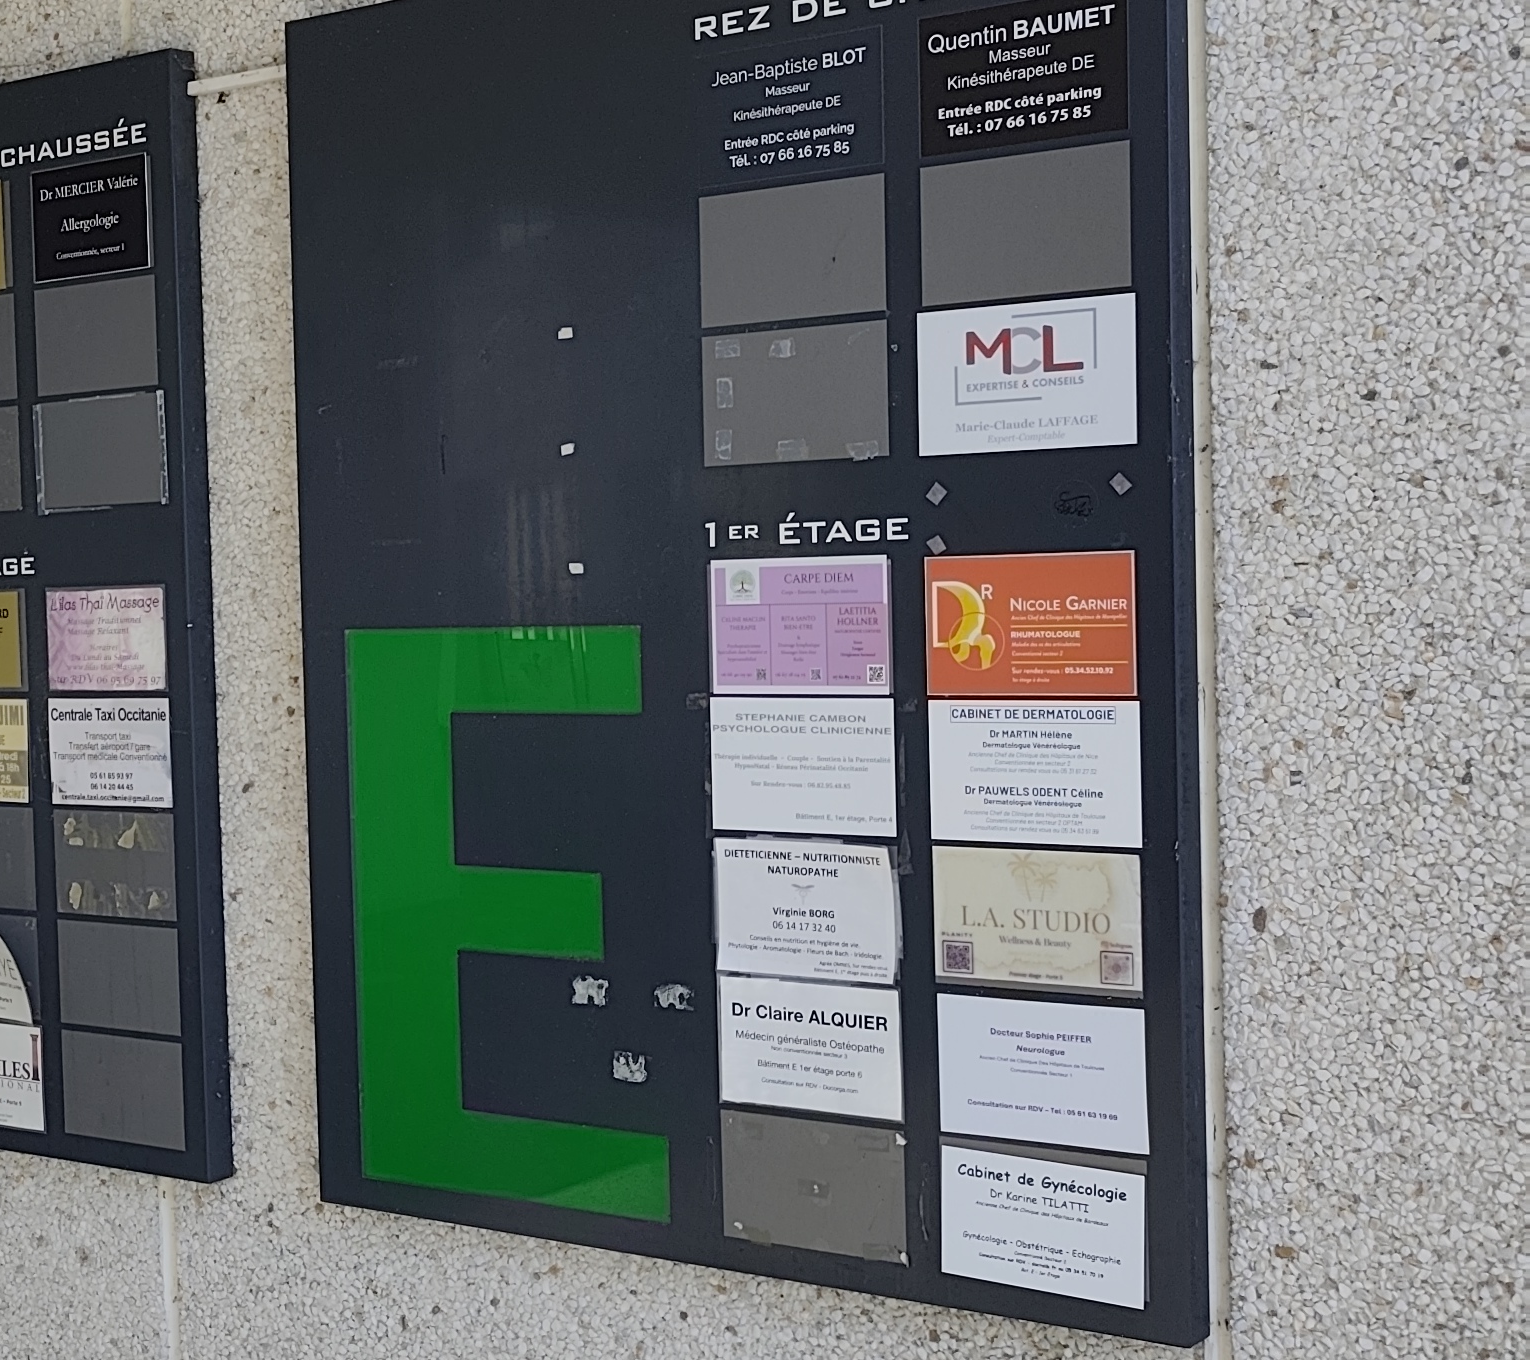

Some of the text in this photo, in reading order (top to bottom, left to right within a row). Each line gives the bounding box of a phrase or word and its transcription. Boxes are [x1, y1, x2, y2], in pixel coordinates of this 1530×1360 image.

[693, 4, 771, 41] REZ
[928, 4, 1115, 53] Quentin BAUMET
[989, 44, 1051, 64] Masseur
[712, 47, 866, 87] Jean-Baptiste BLOT
[947, 55, 1095, 90] Kinésithérapeute DE
[766, 82, 810, 97] Masseur
[734, 95, 841, 122] Kinésithérapeute DE
[938, 87, 1102, 119] Entrée RDC côté parking
[947, 105, 1091, 137] Tél. 07 66 16 75 85
[0, 118, 146, 168] CHAUSSÉE
[725, 123, 854, 150] Entrée RDC côté parking
[730, 141, 850, 167] Tél. 07 66 16 75 85
[40, 175, 138, 201] Dr MERCIER Valérie
[61, 213, 119, 233] Allergologie
[966, 325, 1084, 375] MCL
[967, 376, 1084, 393] EXPERTISE & CONSEILS
[955, 415, 1098, 432] Marie-Claude LAFFAGE
[987, 431, 1065, 444] Expert-Comptable
[779, 512, 909, 544] ÉTAGE
[784, 573, 854, 583] CARPE DIEM
[51, 597, 76, 611] Lilas
[106, 594, 159, 613] Massage
[839, 607, 876, 615] LAETITIA
[837, 618, 878, 626] HOLLNER
[51, 708, 166, 721] Centrale Taxi Occitanie
[736, 713, 866, 723] STEPHANIE CAMBON
[952, 709, 1115, 720] CABINET DE DERMATOLOGIE
[713, 725, 891, 735] PSYCHOLOGUE CLINICIENNE
[989, 730, 1072, 739] Dr MARTIN Hélène
[965, 786, 1103, 799] Dr PAUWELS ODENT Céline
[725, 849, 880, 865] DIETETICIENNE NUTRITIONNISTE
[768, 865, 839, 878] NATUROPATHE
[773, 907, 835, 918] Virginie BORG
[961, 905, 1111, 934] L.A. STUDIO
[344, 625, 670, 1225] E
[773, 921, 836, 933] 06 14 17 32 40
[732, 1002, 888, 1031] Dr Claire ALQUIER
[735, 1030, 885, 1054] Médecin généraliste Ostéopathe
[990, 1028, 1091, 1043] Docteur Sophie PEIFFER
[1016, 1045, 1065, 1056] Neurologue
[958, 1164, 1127, 1202] Cabinet de Gynécologie
[990, 1189, 1089, 1213] Dr Karine TILATTI
